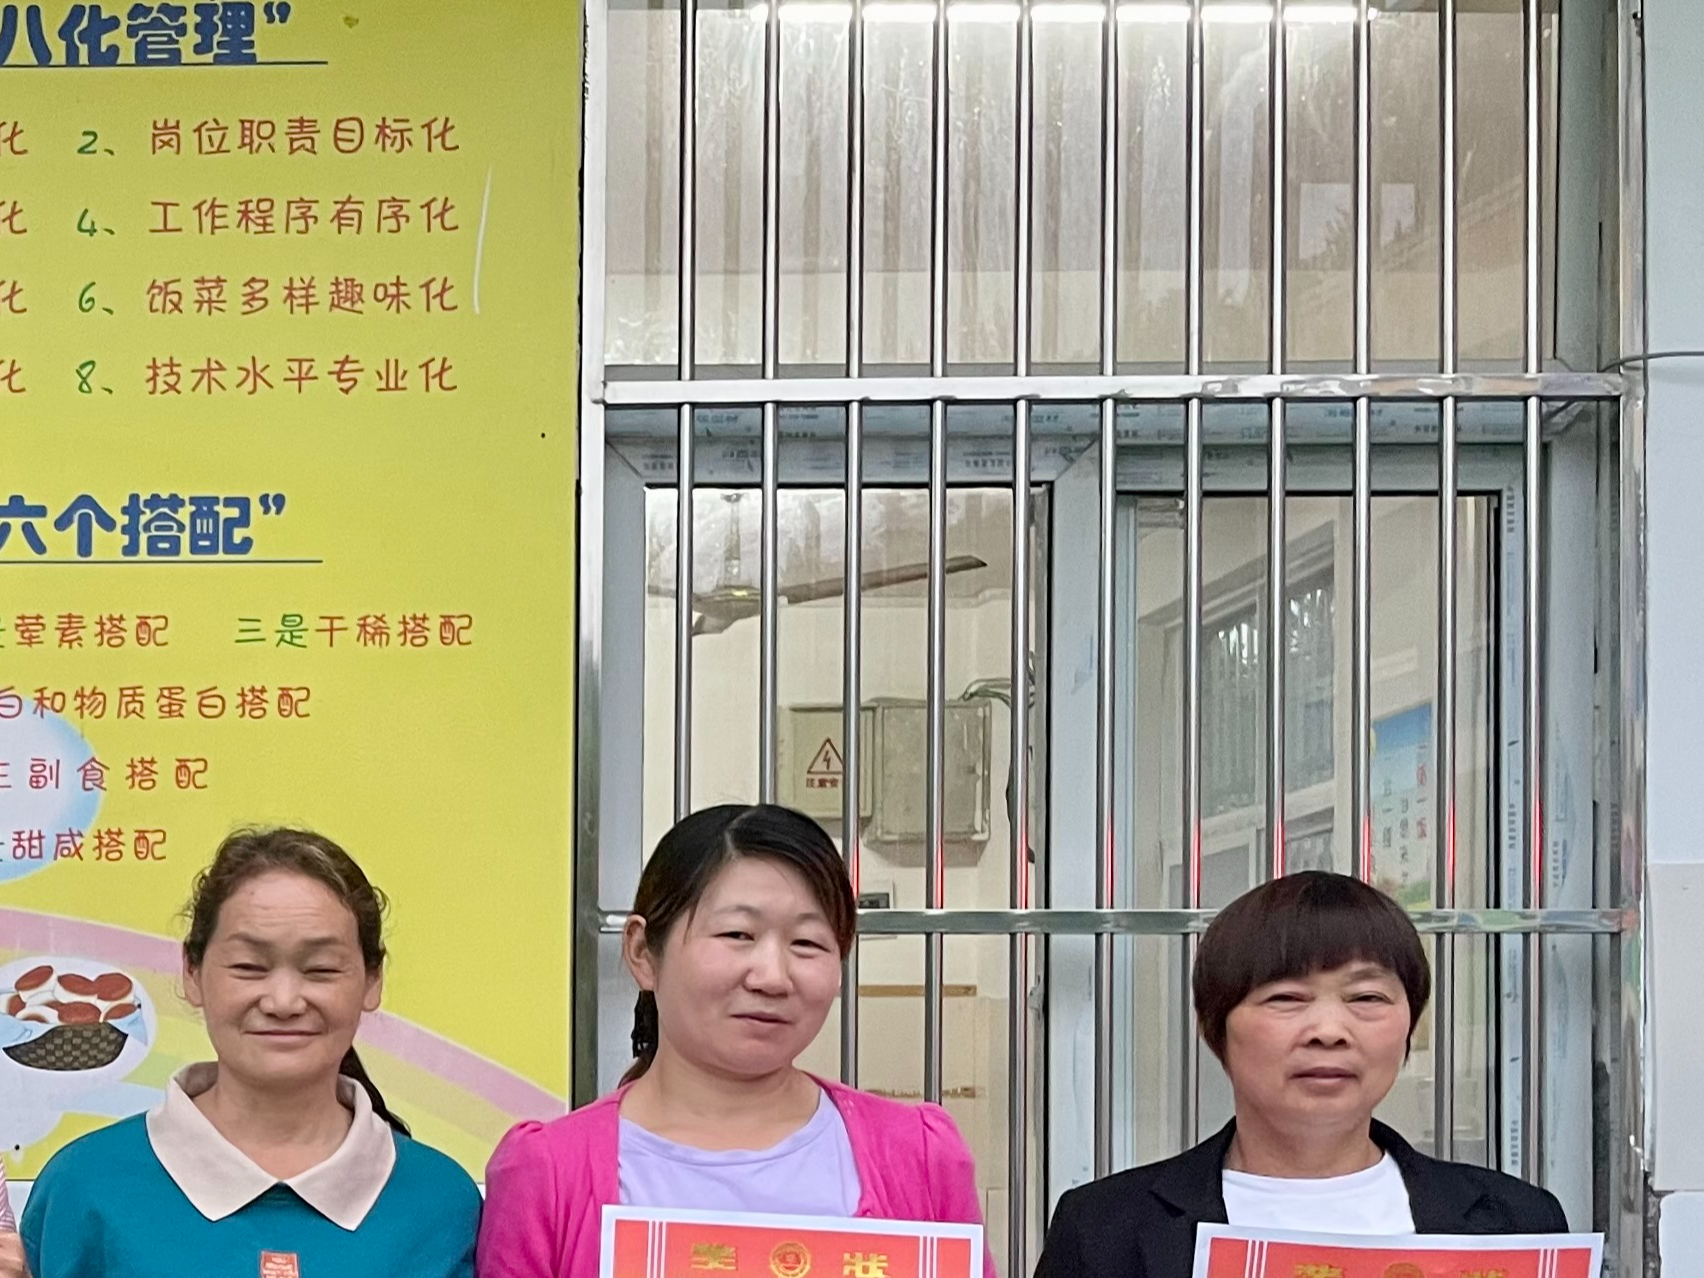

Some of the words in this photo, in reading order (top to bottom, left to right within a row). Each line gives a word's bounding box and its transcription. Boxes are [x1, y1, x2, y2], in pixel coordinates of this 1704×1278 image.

[234, 614, 473, 649] 三是干稀搭配
